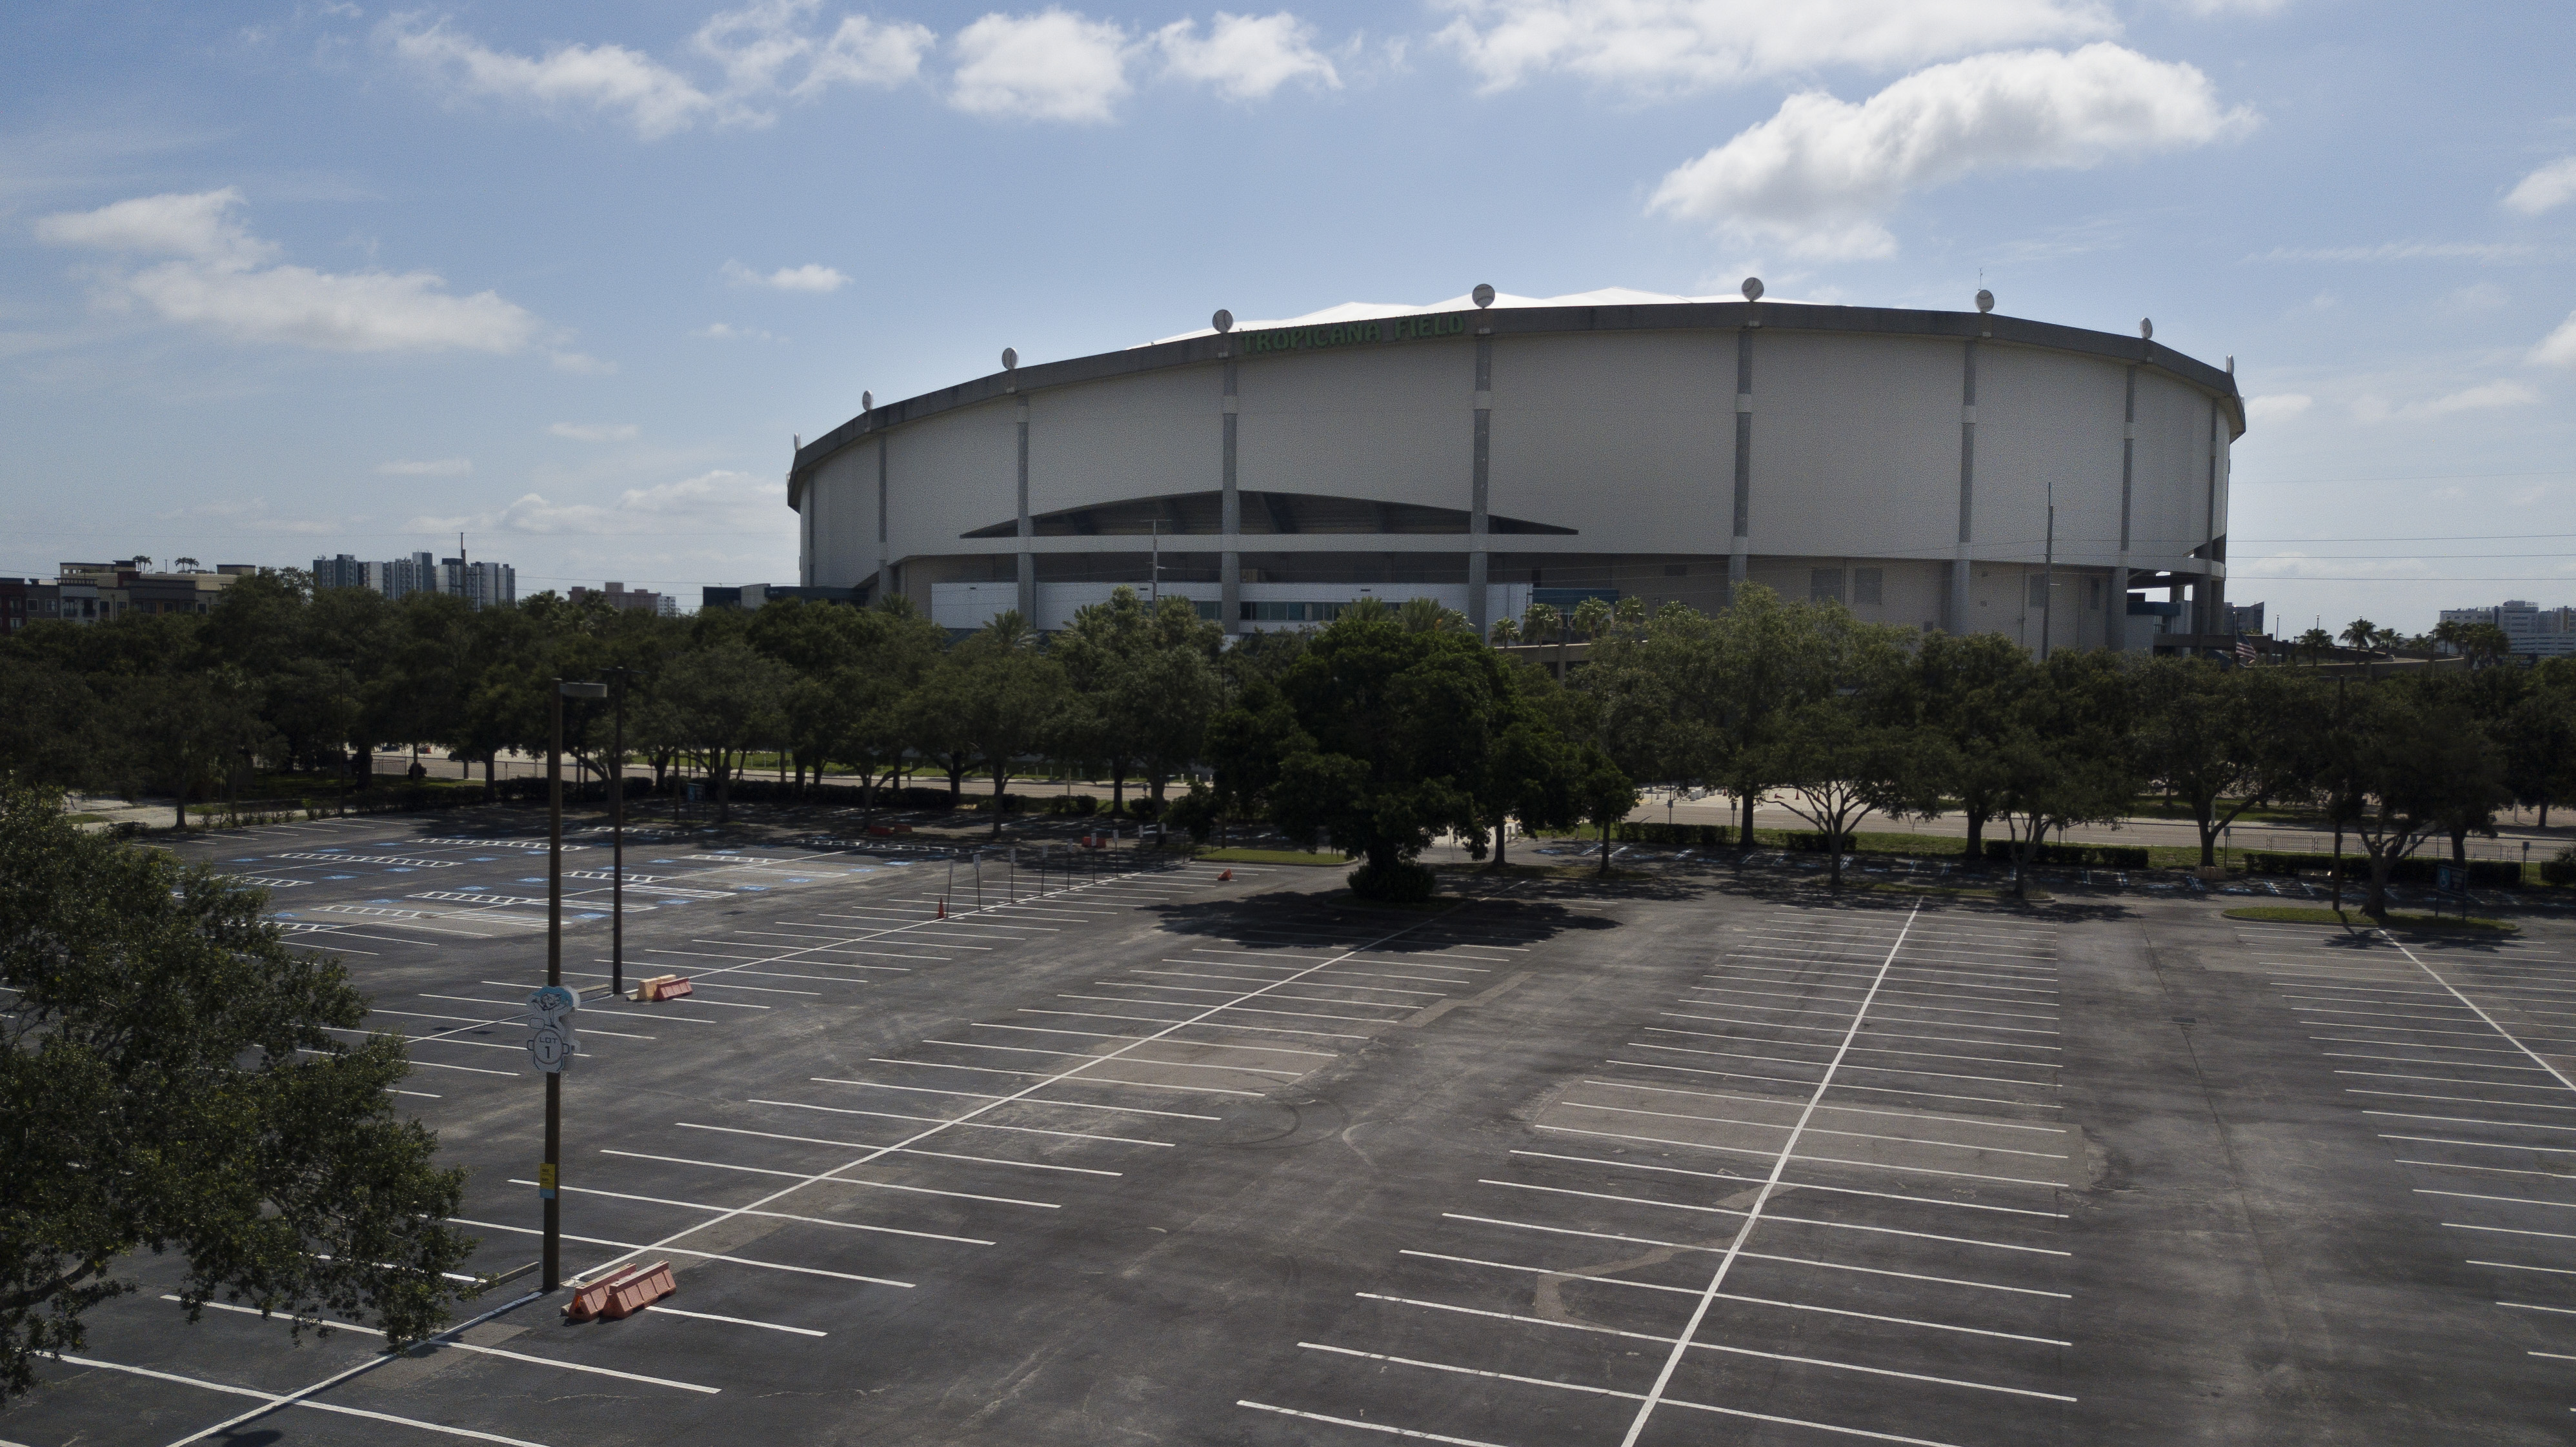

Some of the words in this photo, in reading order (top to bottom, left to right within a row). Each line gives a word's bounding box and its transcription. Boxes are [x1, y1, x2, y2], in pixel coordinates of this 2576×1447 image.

[1241, 321, 1382, 353] TROPICANA
[1395, 312, 1464, 339] FIELD
[545, 1046, 550, 1059] 1
